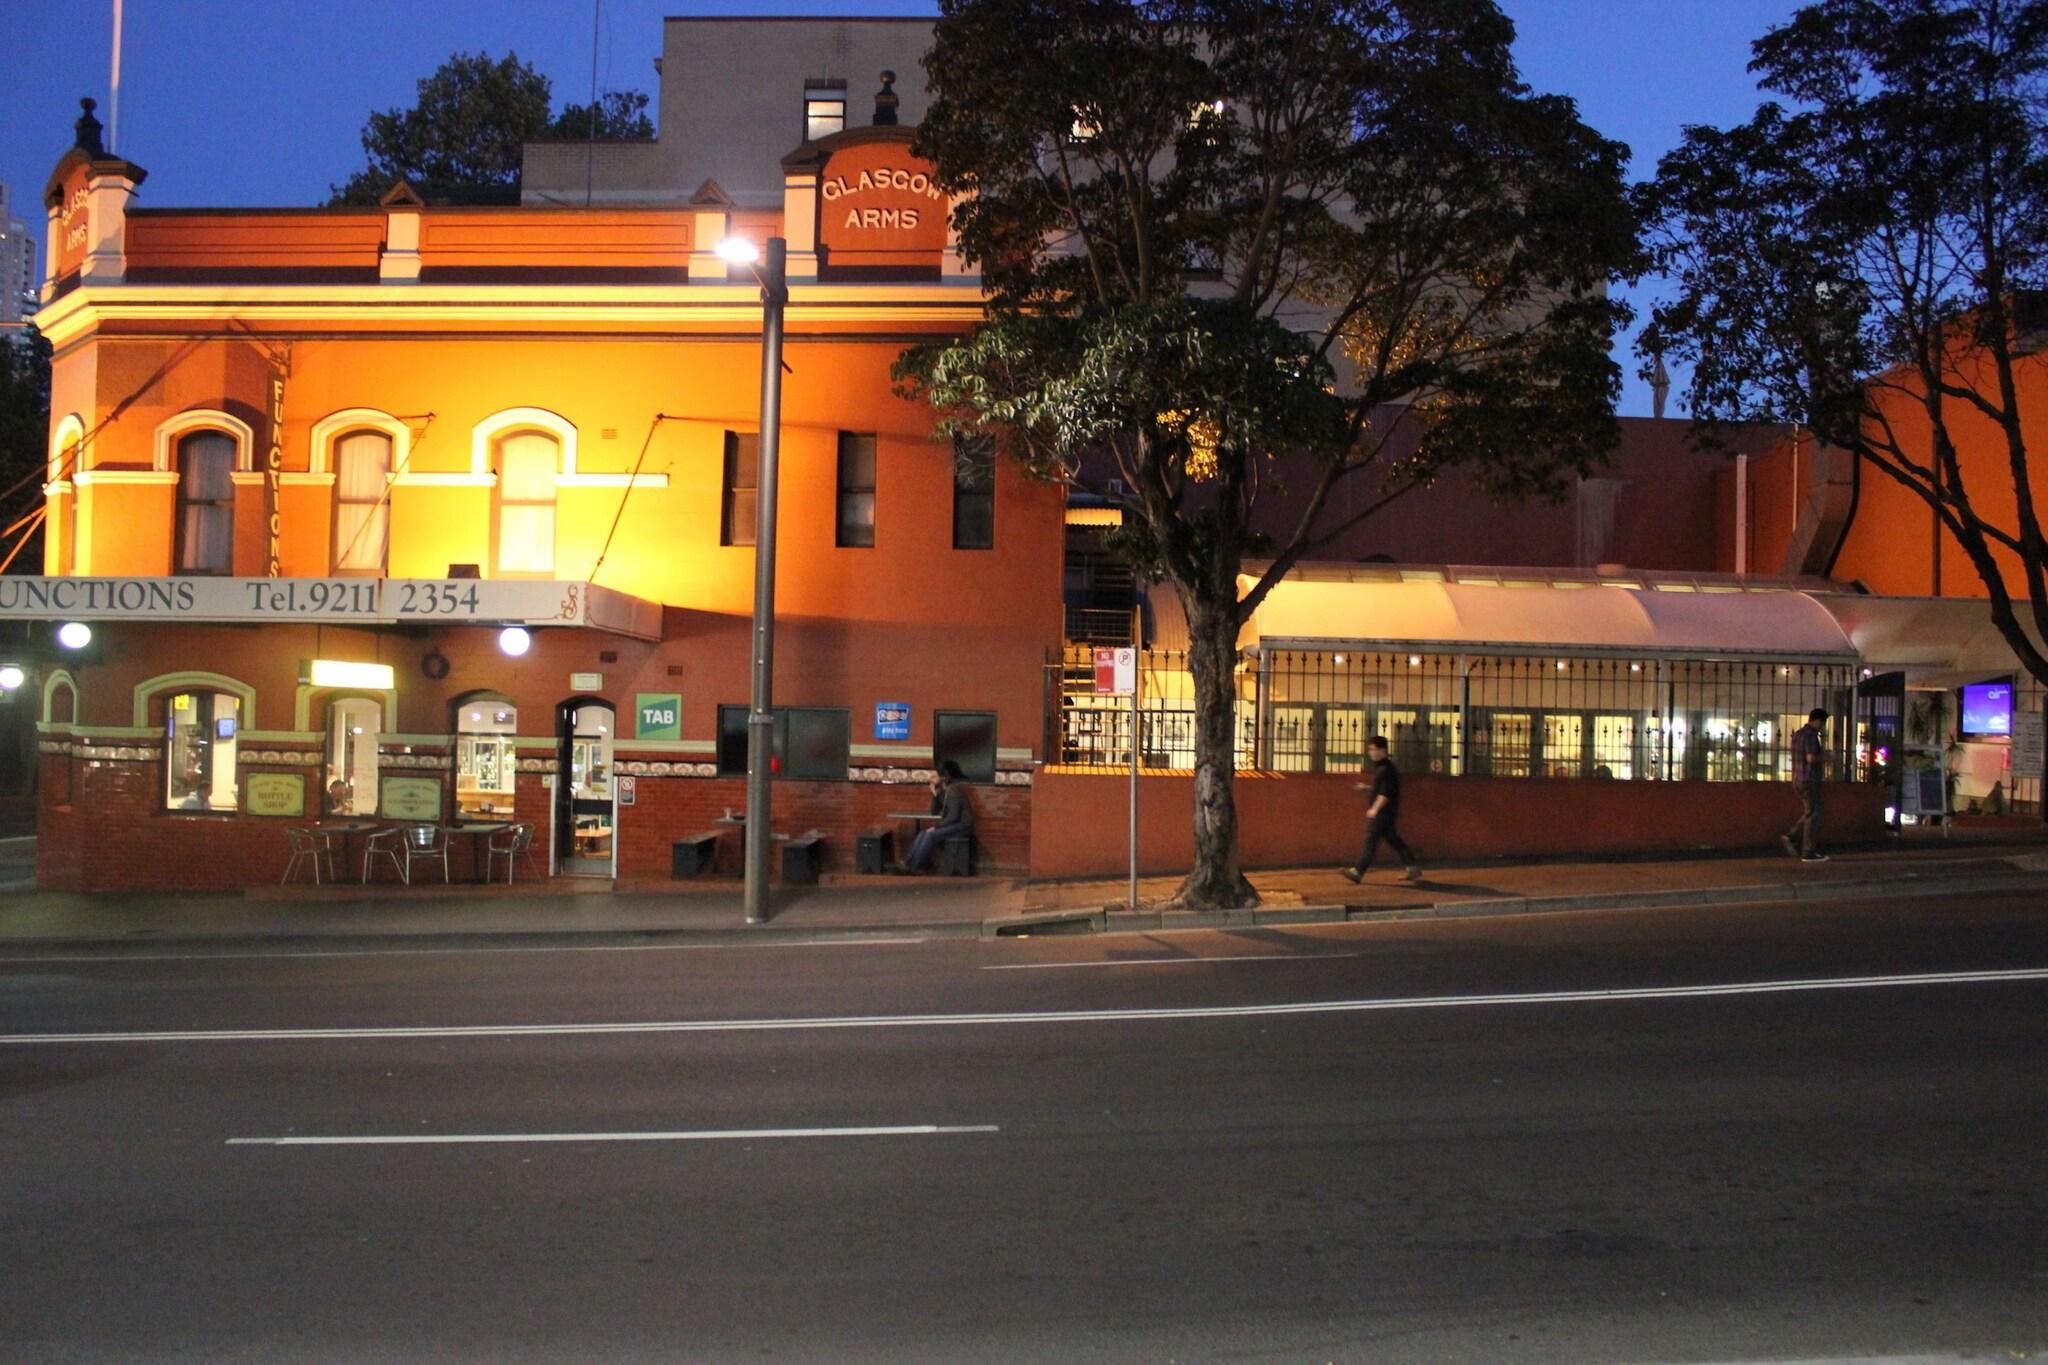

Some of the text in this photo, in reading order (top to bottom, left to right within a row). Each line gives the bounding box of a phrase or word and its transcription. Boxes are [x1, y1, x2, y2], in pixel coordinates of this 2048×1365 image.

[822, 169, 944, 201] GLASGOW
[845, 209, 919, 230] ARMS
[268, 379, 285, 579] FUNCTIONS
[245, 581, 378, 613] Tel.9211
[399, 582, 480, 615] 2354
[642, 709, 675, 725] TAB
